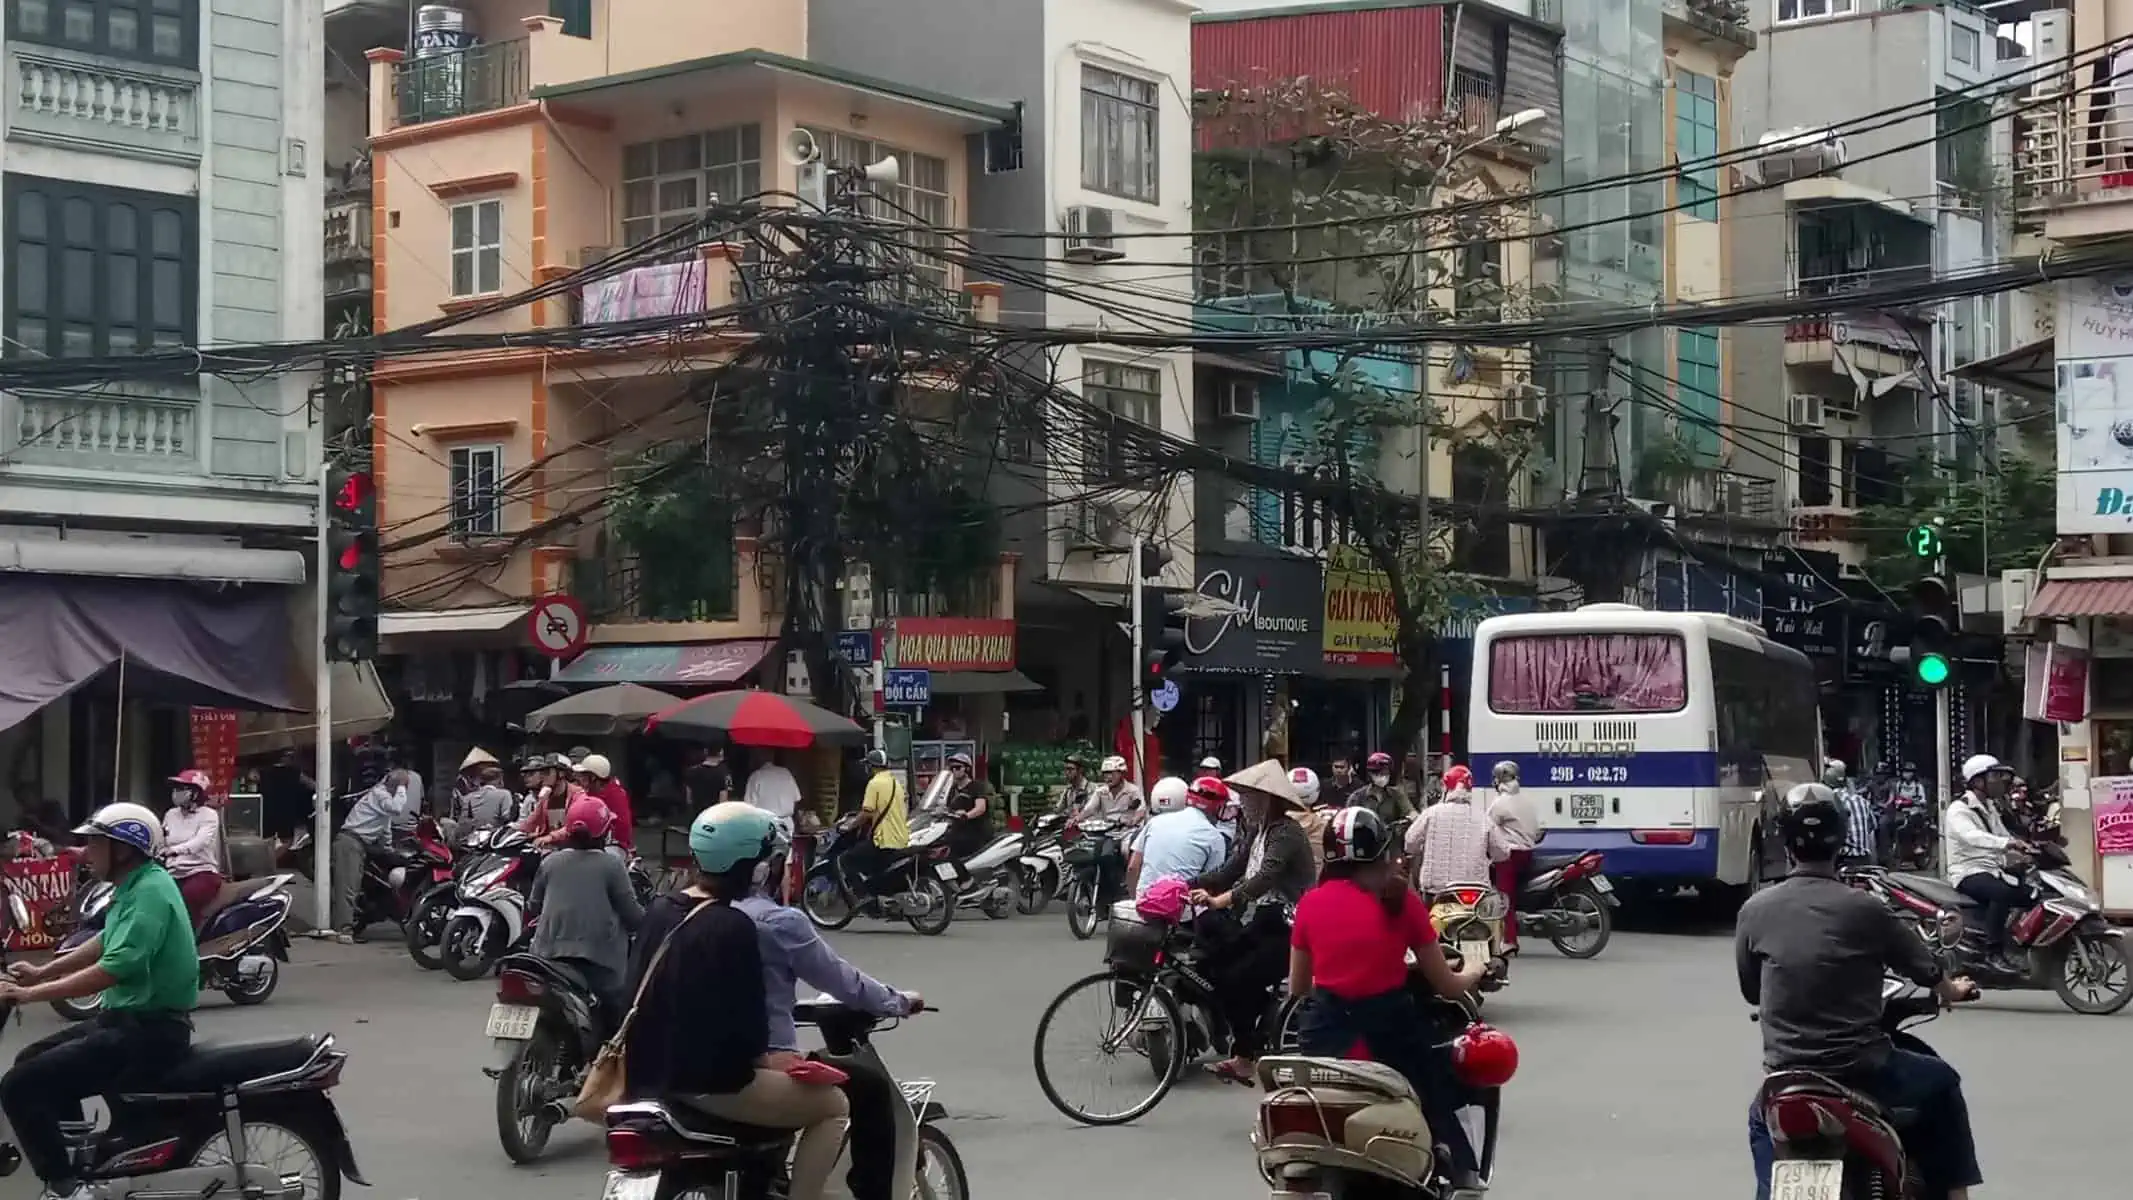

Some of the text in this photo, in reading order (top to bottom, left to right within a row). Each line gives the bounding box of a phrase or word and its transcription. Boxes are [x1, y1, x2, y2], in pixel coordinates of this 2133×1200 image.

[1918, 529, 1930, 556] 2
[1259, 617, 1308, 632] BOUTIQUE
[899, 633, 922, 664] HOA
[1538, 742, 1636, 758] HYUNDAI
[1550, 766, 1574, 782] 29B
